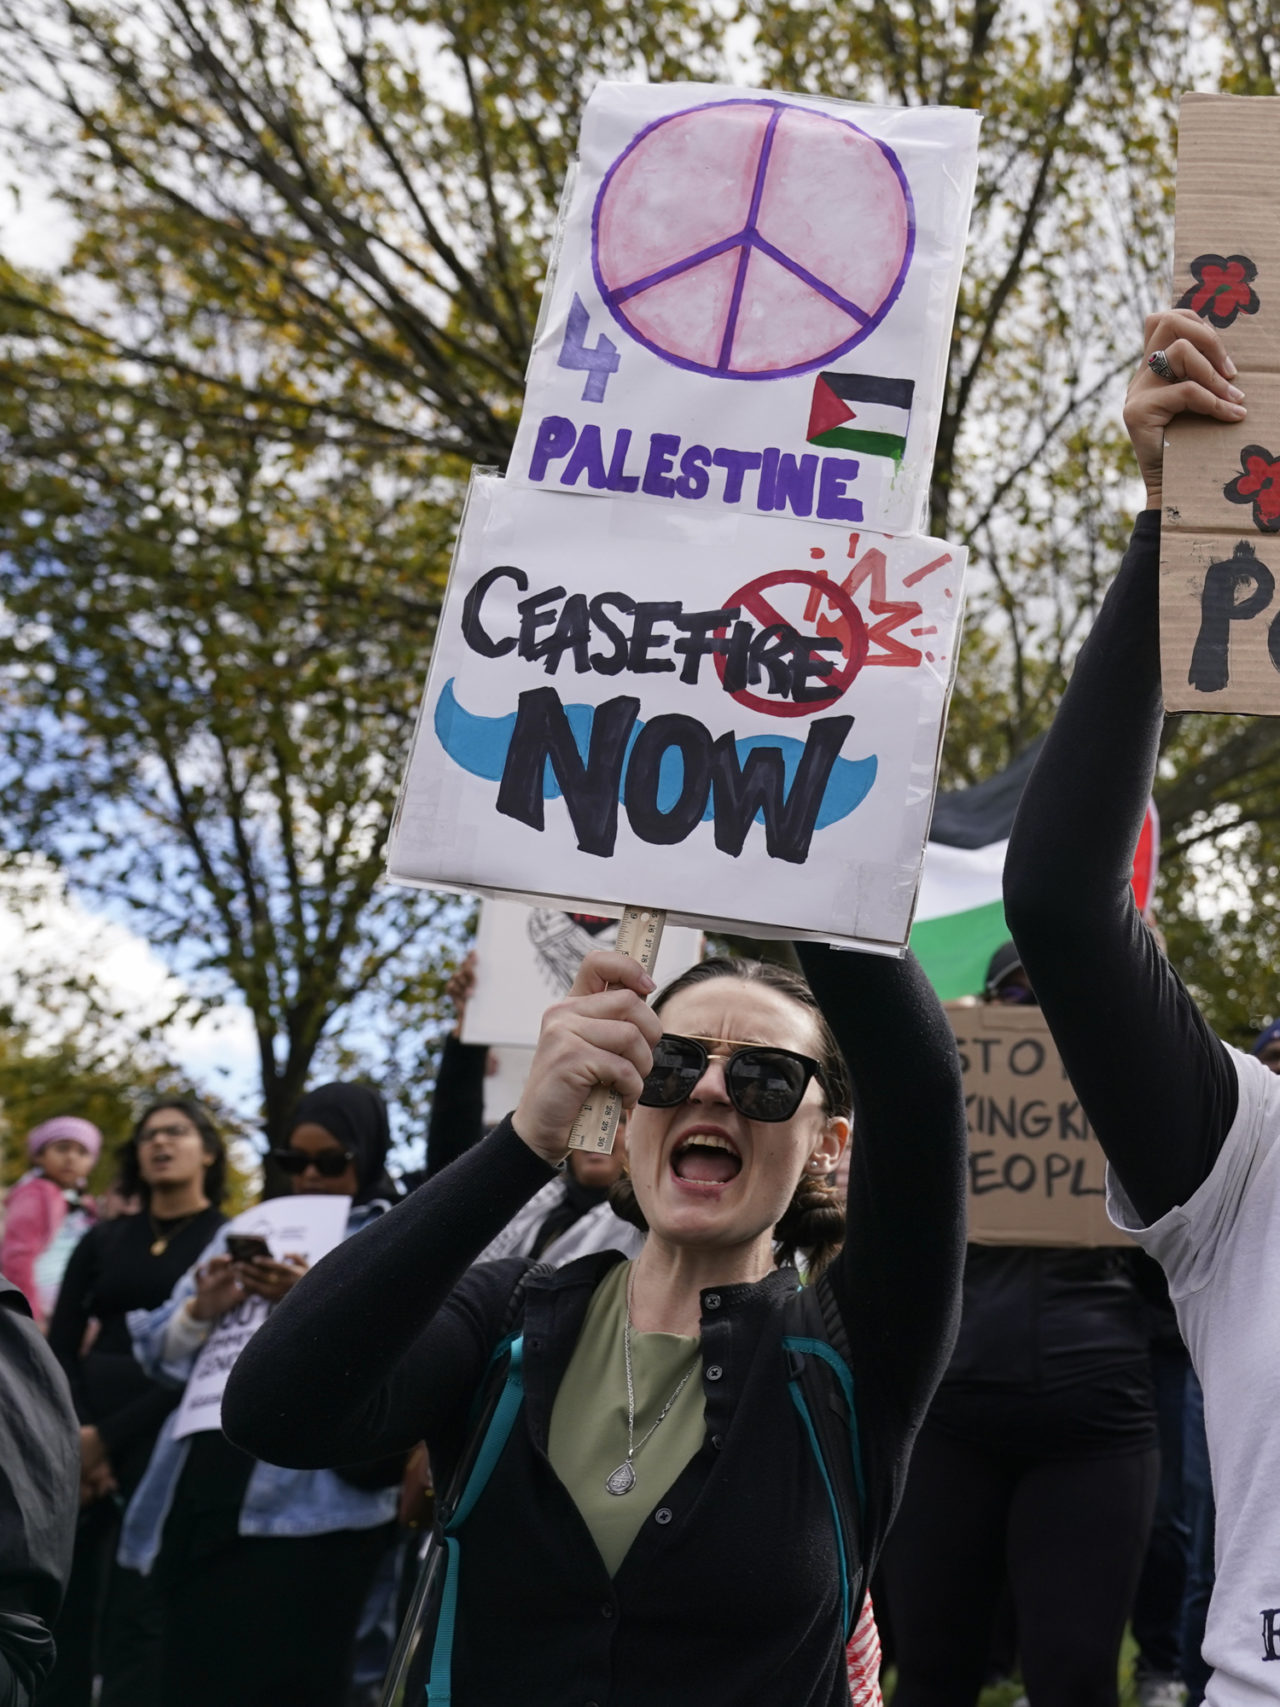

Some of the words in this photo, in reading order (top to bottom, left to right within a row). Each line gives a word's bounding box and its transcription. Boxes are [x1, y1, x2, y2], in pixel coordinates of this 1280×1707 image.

[557, 291, 621, 404] 4
[528, 415, 864, 522] PALESTINE
[461, 566, 844, 702] CEASEFIRE
[496, 686, 855, 865] NOW
[956, 1037, 1068, 1080] STO
[967, 1150, 1106, 1198] EOPL
